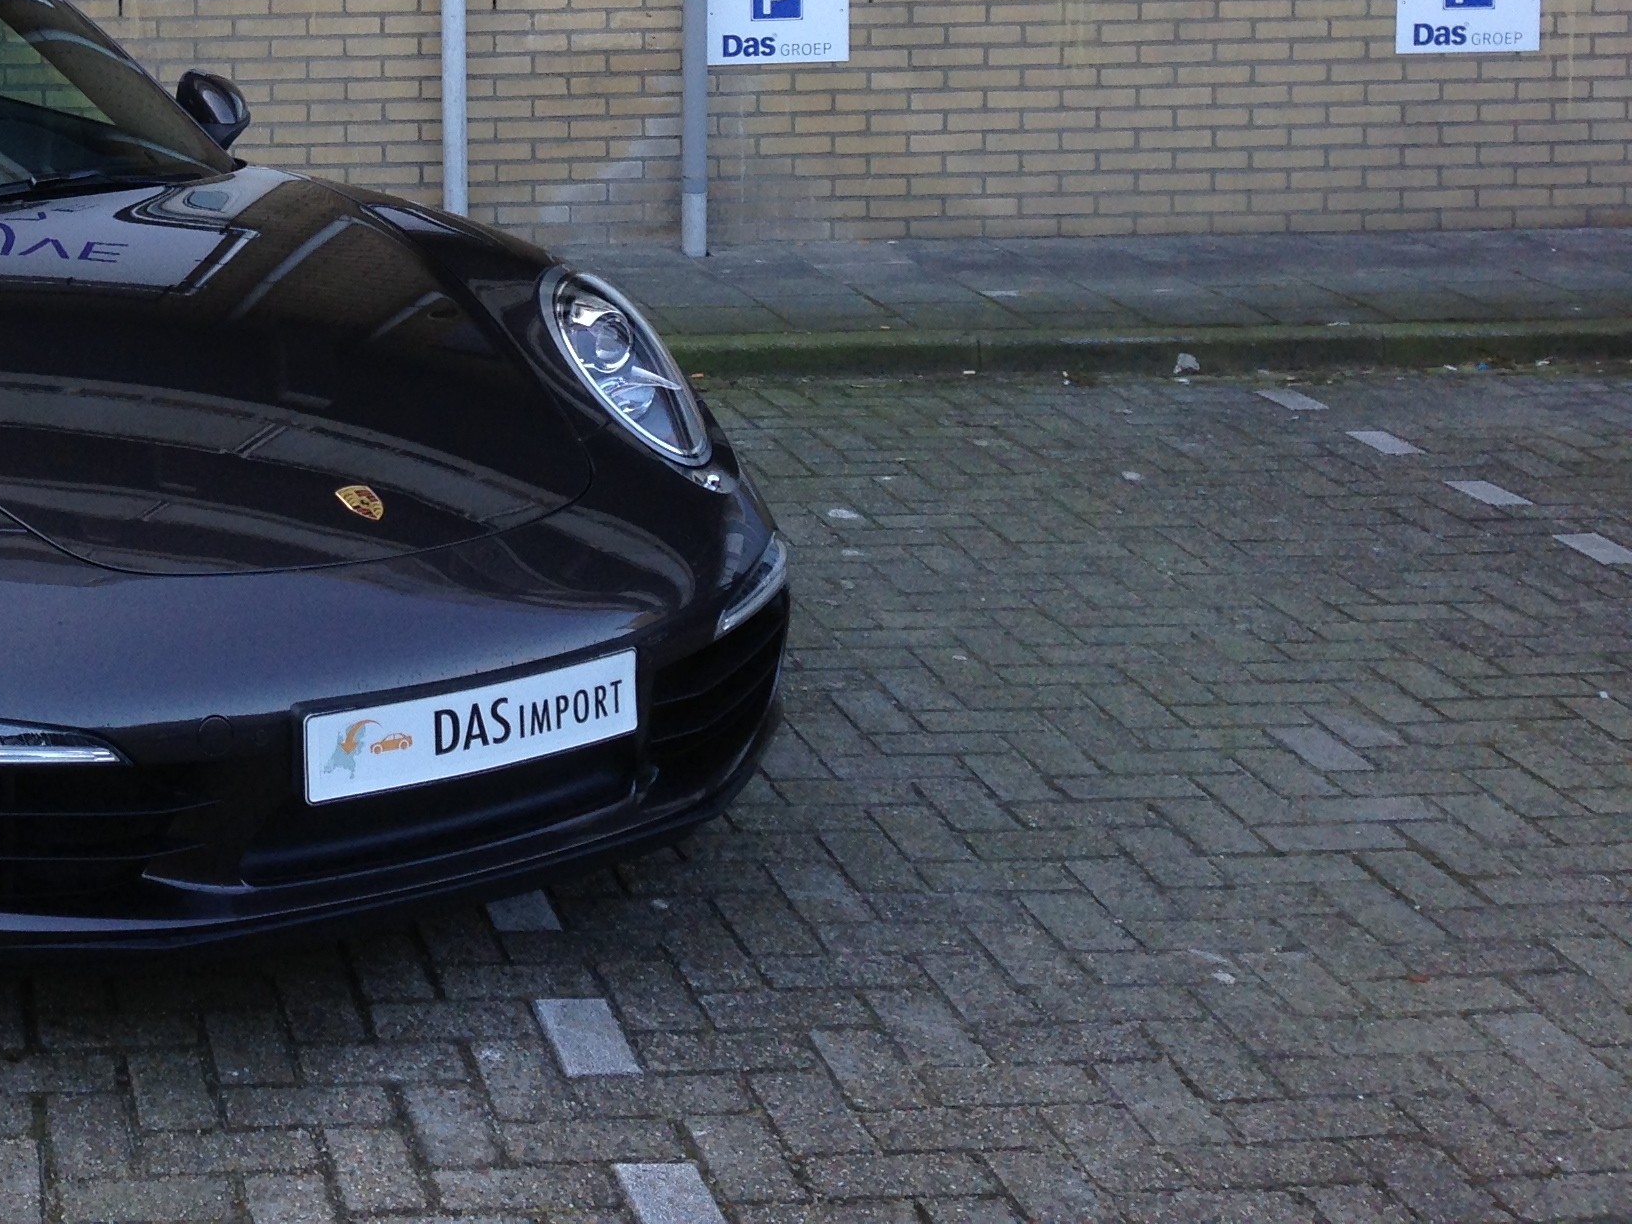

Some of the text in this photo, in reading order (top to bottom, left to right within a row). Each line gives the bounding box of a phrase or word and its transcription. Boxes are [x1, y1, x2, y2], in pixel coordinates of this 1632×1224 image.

[721, 33, 833, 58] Das GROEP
[1412, 22, 1524, 47] Das GROEP
